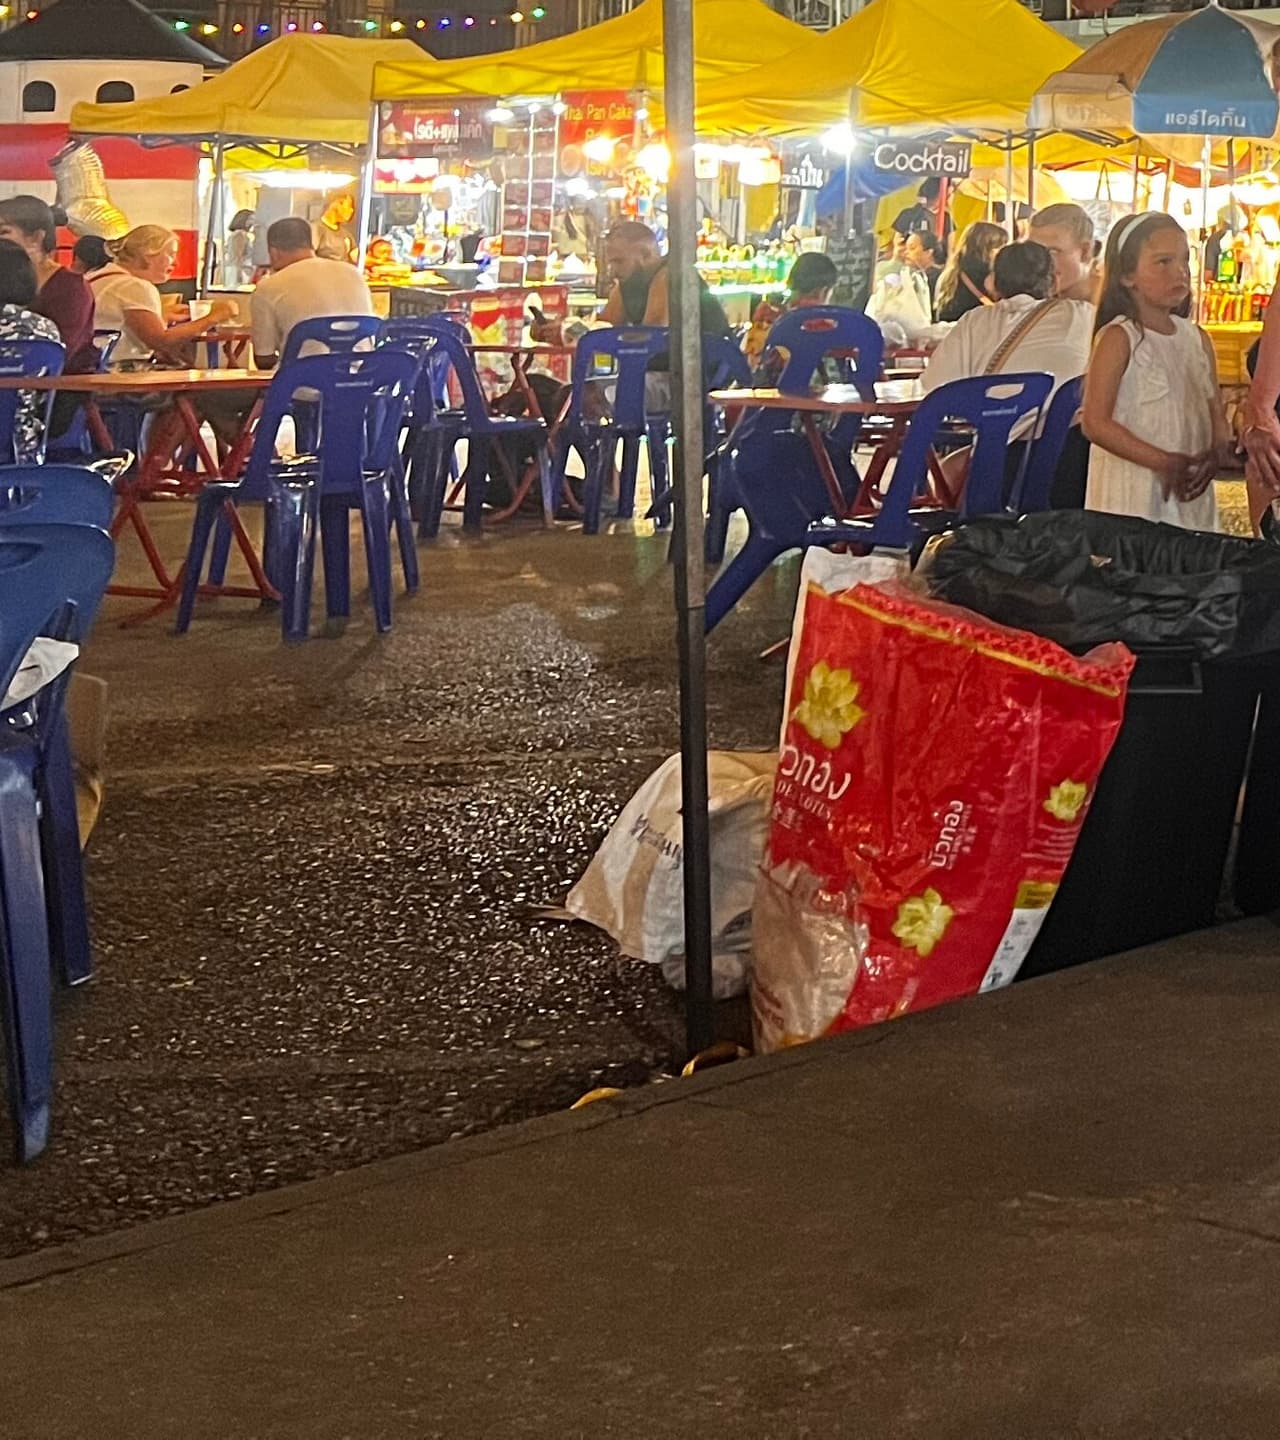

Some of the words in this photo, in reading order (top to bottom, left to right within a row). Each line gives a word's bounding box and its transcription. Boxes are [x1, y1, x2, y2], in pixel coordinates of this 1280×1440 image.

[587, 104, 606, 120] Pan
[1165, 107, 1246, 128] แอร์ไดกิ้น
[873, 143, 970, 173] Cocktail
[780, 744, 852, 800] วทอง
